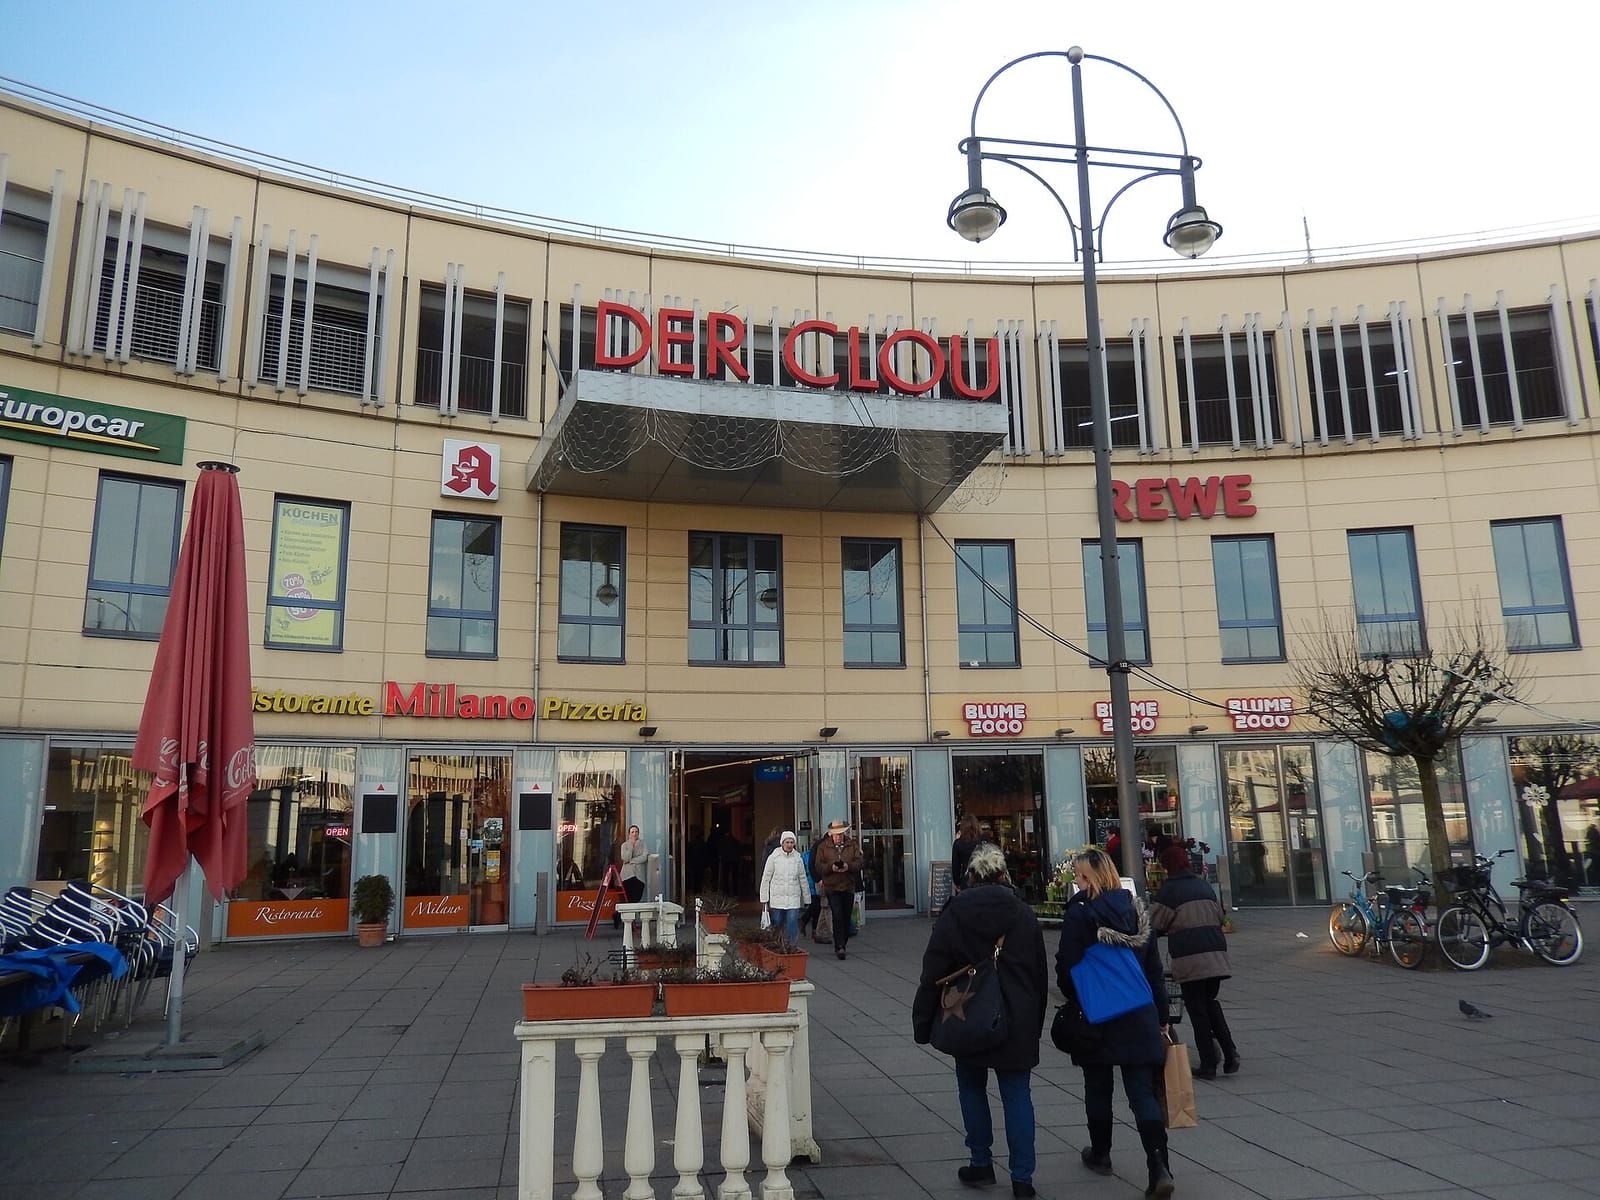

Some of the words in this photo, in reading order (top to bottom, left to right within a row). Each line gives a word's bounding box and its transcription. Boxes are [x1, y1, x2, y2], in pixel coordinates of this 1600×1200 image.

[594, 299, 750, 382] DER
[783, 319, 999, 400] CLOU
[282, 508, 338, 522] KÜCHEN
[284, 576, 304, 588] 70%
[251, 686, 374, 715] istorante
[384, 680, 535, 720] Milano
[542, 696, 647, 721] Pizzeria
[1228, 698, 1292, 715] BLUME
[965, 704, 1026, 719] BLUME
[1096, 701, 1158, 718] BME
[971, 719, 1023, 734] 2000
[1103, 717, 1155, 732] 200
[1235, 714, 1290, 729] 2000
[326, 828, 349, 836] OPEN
[558, 824, 578, 832] OPEN
[411, 895, 464, 916] Milano
[568, 895, 613, 911] Pizzea
[255, 906, 324, 924] Ristorante
